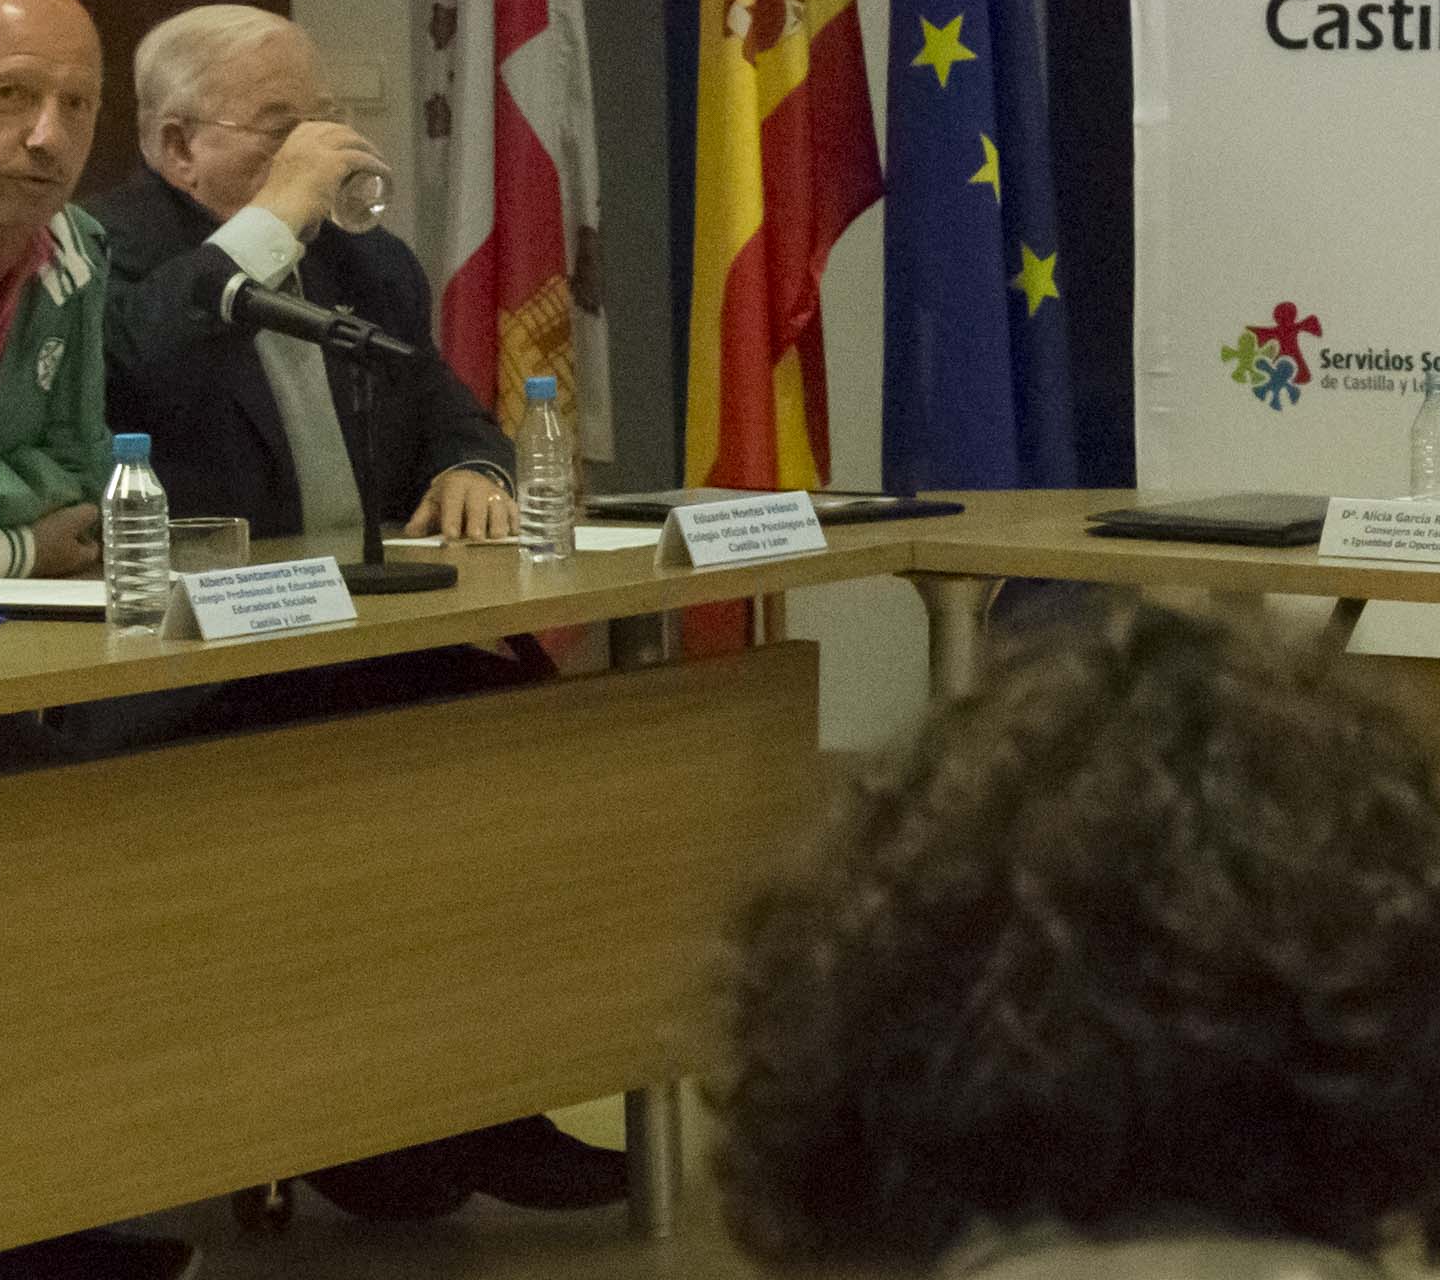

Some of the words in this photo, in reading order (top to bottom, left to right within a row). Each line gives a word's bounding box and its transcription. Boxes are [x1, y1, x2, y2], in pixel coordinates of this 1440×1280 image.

[1319, 348, 1415, 372] Servicios
[1320, 373, 1339, 390] de
[1342, 374, 1395, 392] Castilla
[1399, 380, 1408, 396] y
[1362, 511, 1392, 522] Alicia
[1364, 525, 1413, 537] Consejera
[1413, 527, 1425, 537] de
[728, 540, 760, 552] Castilla
[1352, 537, 1393, 549] Igualdad
[1395, 539, 1407, 548] de
[199, 576, 235, 588] Alberto
[226, 586, 274, 599] Profesional
[281, 596, 317, 607] Sociales
[250, 618, 282, 629] Castilla
